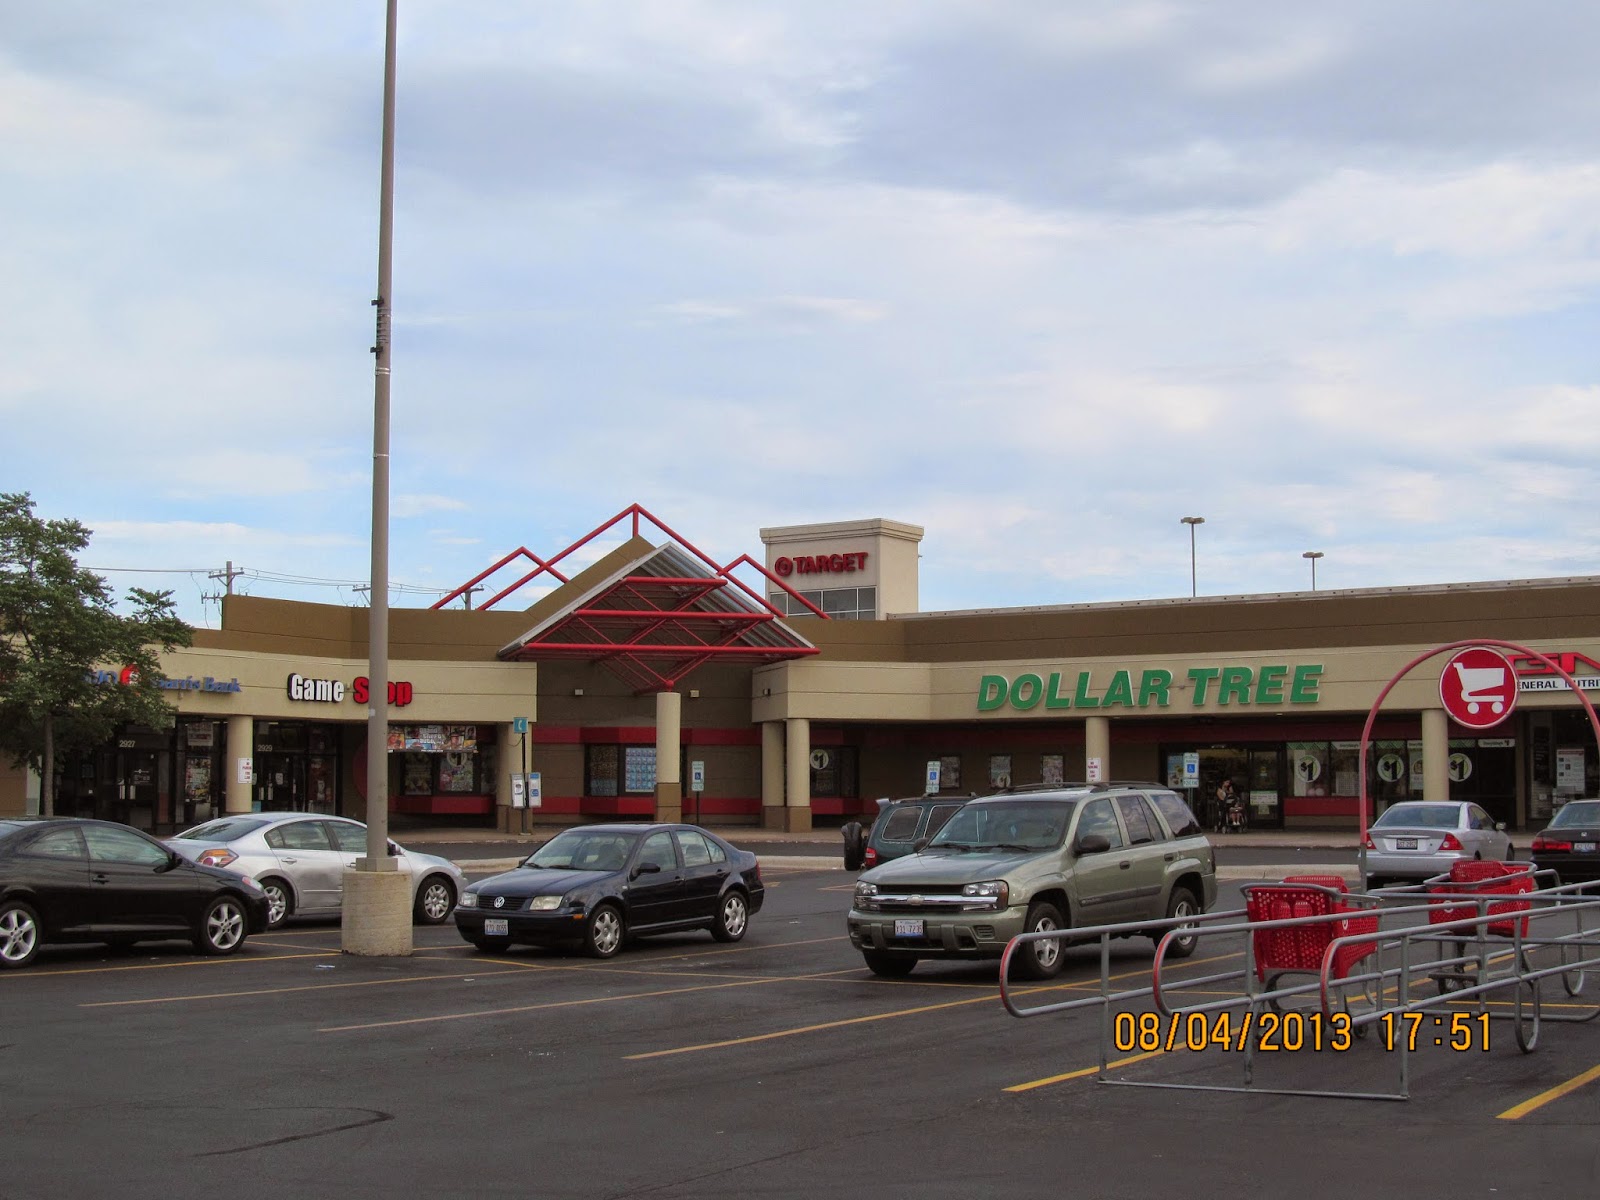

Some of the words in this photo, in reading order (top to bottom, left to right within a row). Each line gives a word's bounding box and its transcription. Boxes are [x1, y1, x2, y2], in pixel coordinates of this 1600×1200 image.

[792, 552, 868, 574] TARGET
[202, 677, 242, 693] Bank
[288, 673, 345, 703] Game
[353, 676, 413, 707] Sop
[978, 669, 1173, 710] DOLLAR
[1187, 665, 1323, 706] TREE
[119, 740, 135, 748] 2927
[257, 744, 273, 752] 2929
[1300, 761, 1314, 781] $1
[1384, 760, 1398, 781] $1
[1450, 760, 1465, 780] $1
